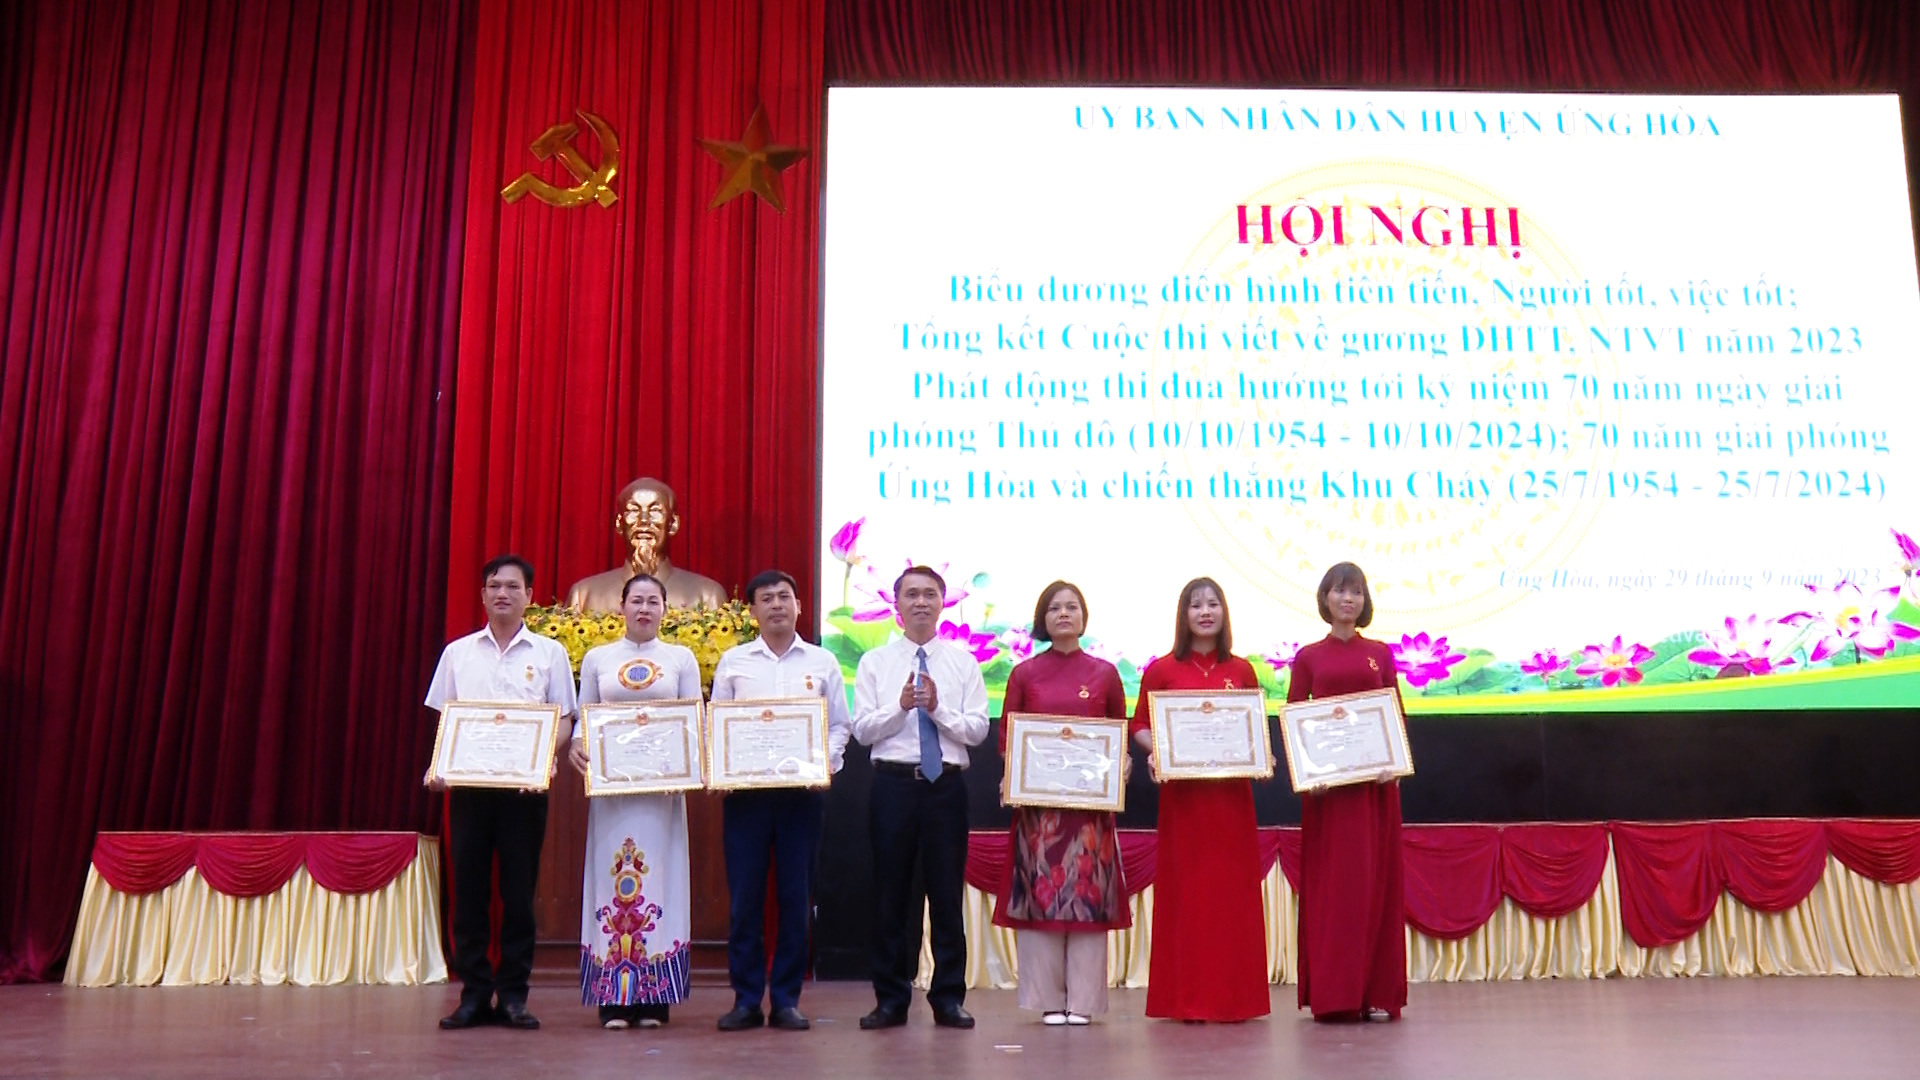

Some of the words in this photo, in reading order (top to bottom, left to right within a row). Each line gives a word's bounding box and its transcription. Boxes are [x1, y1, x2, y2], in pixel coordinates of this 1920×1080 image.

[1136, 105, 1204, 130] BAN
[1221, 100, 1319, 132] NHÂN
[1335, 102, 1405, 132] DÂN
[1421, 107, 1541, 141] HUYỆN
[1557, 106, 1631, 135] ỨNG
[1646, 106, 1720, 136] HÒA
[1237, 199, 1345, 257] HỘI
[1370, 206, 1520, 259] NGHỊ
[1038, 274, 1149, 309] dương
[1247, 274, 1320, 304] hình
[1335, 274, 1394, 304] tiên
[1409, 269, 1479, 307] tiến,
[1492, 278, 1591, 311] Người
[1605, 272, 1656, 308] tốt,
[1669, 275, 1728, 312] việc
[1743, 274, 1797, 309] tốt;
[997, 315, 1045, 351] kết
[1061, 322, 1149, 358] Cuộc
[1163, 322, 1206, 352] thi
[1221, 316, 1279, 352] viết
[1294, 316, 1328, 352] về
[1341, 330, 1448, 358] gương
[1461, 322, 1576, 355] ĐHTT,
[1589, 325, 1690, 354] NTVT
[1706, 329, 1774, 354] năm
[1789, 326, 1862, 355] 2023
[914, 370, 990, 400] Phát
[1005, 370, 1089, 408] động
[1103, 370, 1146, 400] thi
[1161, 370, 1223, 400] đua
[1239, 370, 1348, 407] hướng
[1361, 372, 1403, 400] tới
[1470, 371, 1549, 408] niệm
[1613, 374, 1681, 401] 70
[1696, 374, 1768, 408] năm
[1696, 382, 1768, 408] ngày
[869, 420, 977, 456] phóng
[1075, 419, 1114, 449] đô
[1129, 419, 1327, 453] (10/10/1954
[1368, 420, 1568, 453] 10/10/2024);
[1583, 421, 1618, 448] 70
[1633, 422, 1702, 450] năm
[1787, 422, 1890, 456] phóng
[876, 461, 951, 504] Ứng
[967, 469, 1035, 500] Hòa
[1051, 470, 1088, 499] và
[1103, 461, 1193, 500] chiến
[1209, 462, 1307, 505] thắng
[1321, 468, 1392, 500] Khu
[1509, 469, 1679, 502] (25/7/1954
[1717, 469, 1885, 501] 25/7/2024)
[1606, 567, 1657, 592] ngày
[1664, 567, 1688, 588] 29
[1695, 567, 1753, 592] tháng
[1761, 567, 1773, 588] 9
[1779, 567, 1824, 588] năm
[1832, 567, 1882, 587] 2023
